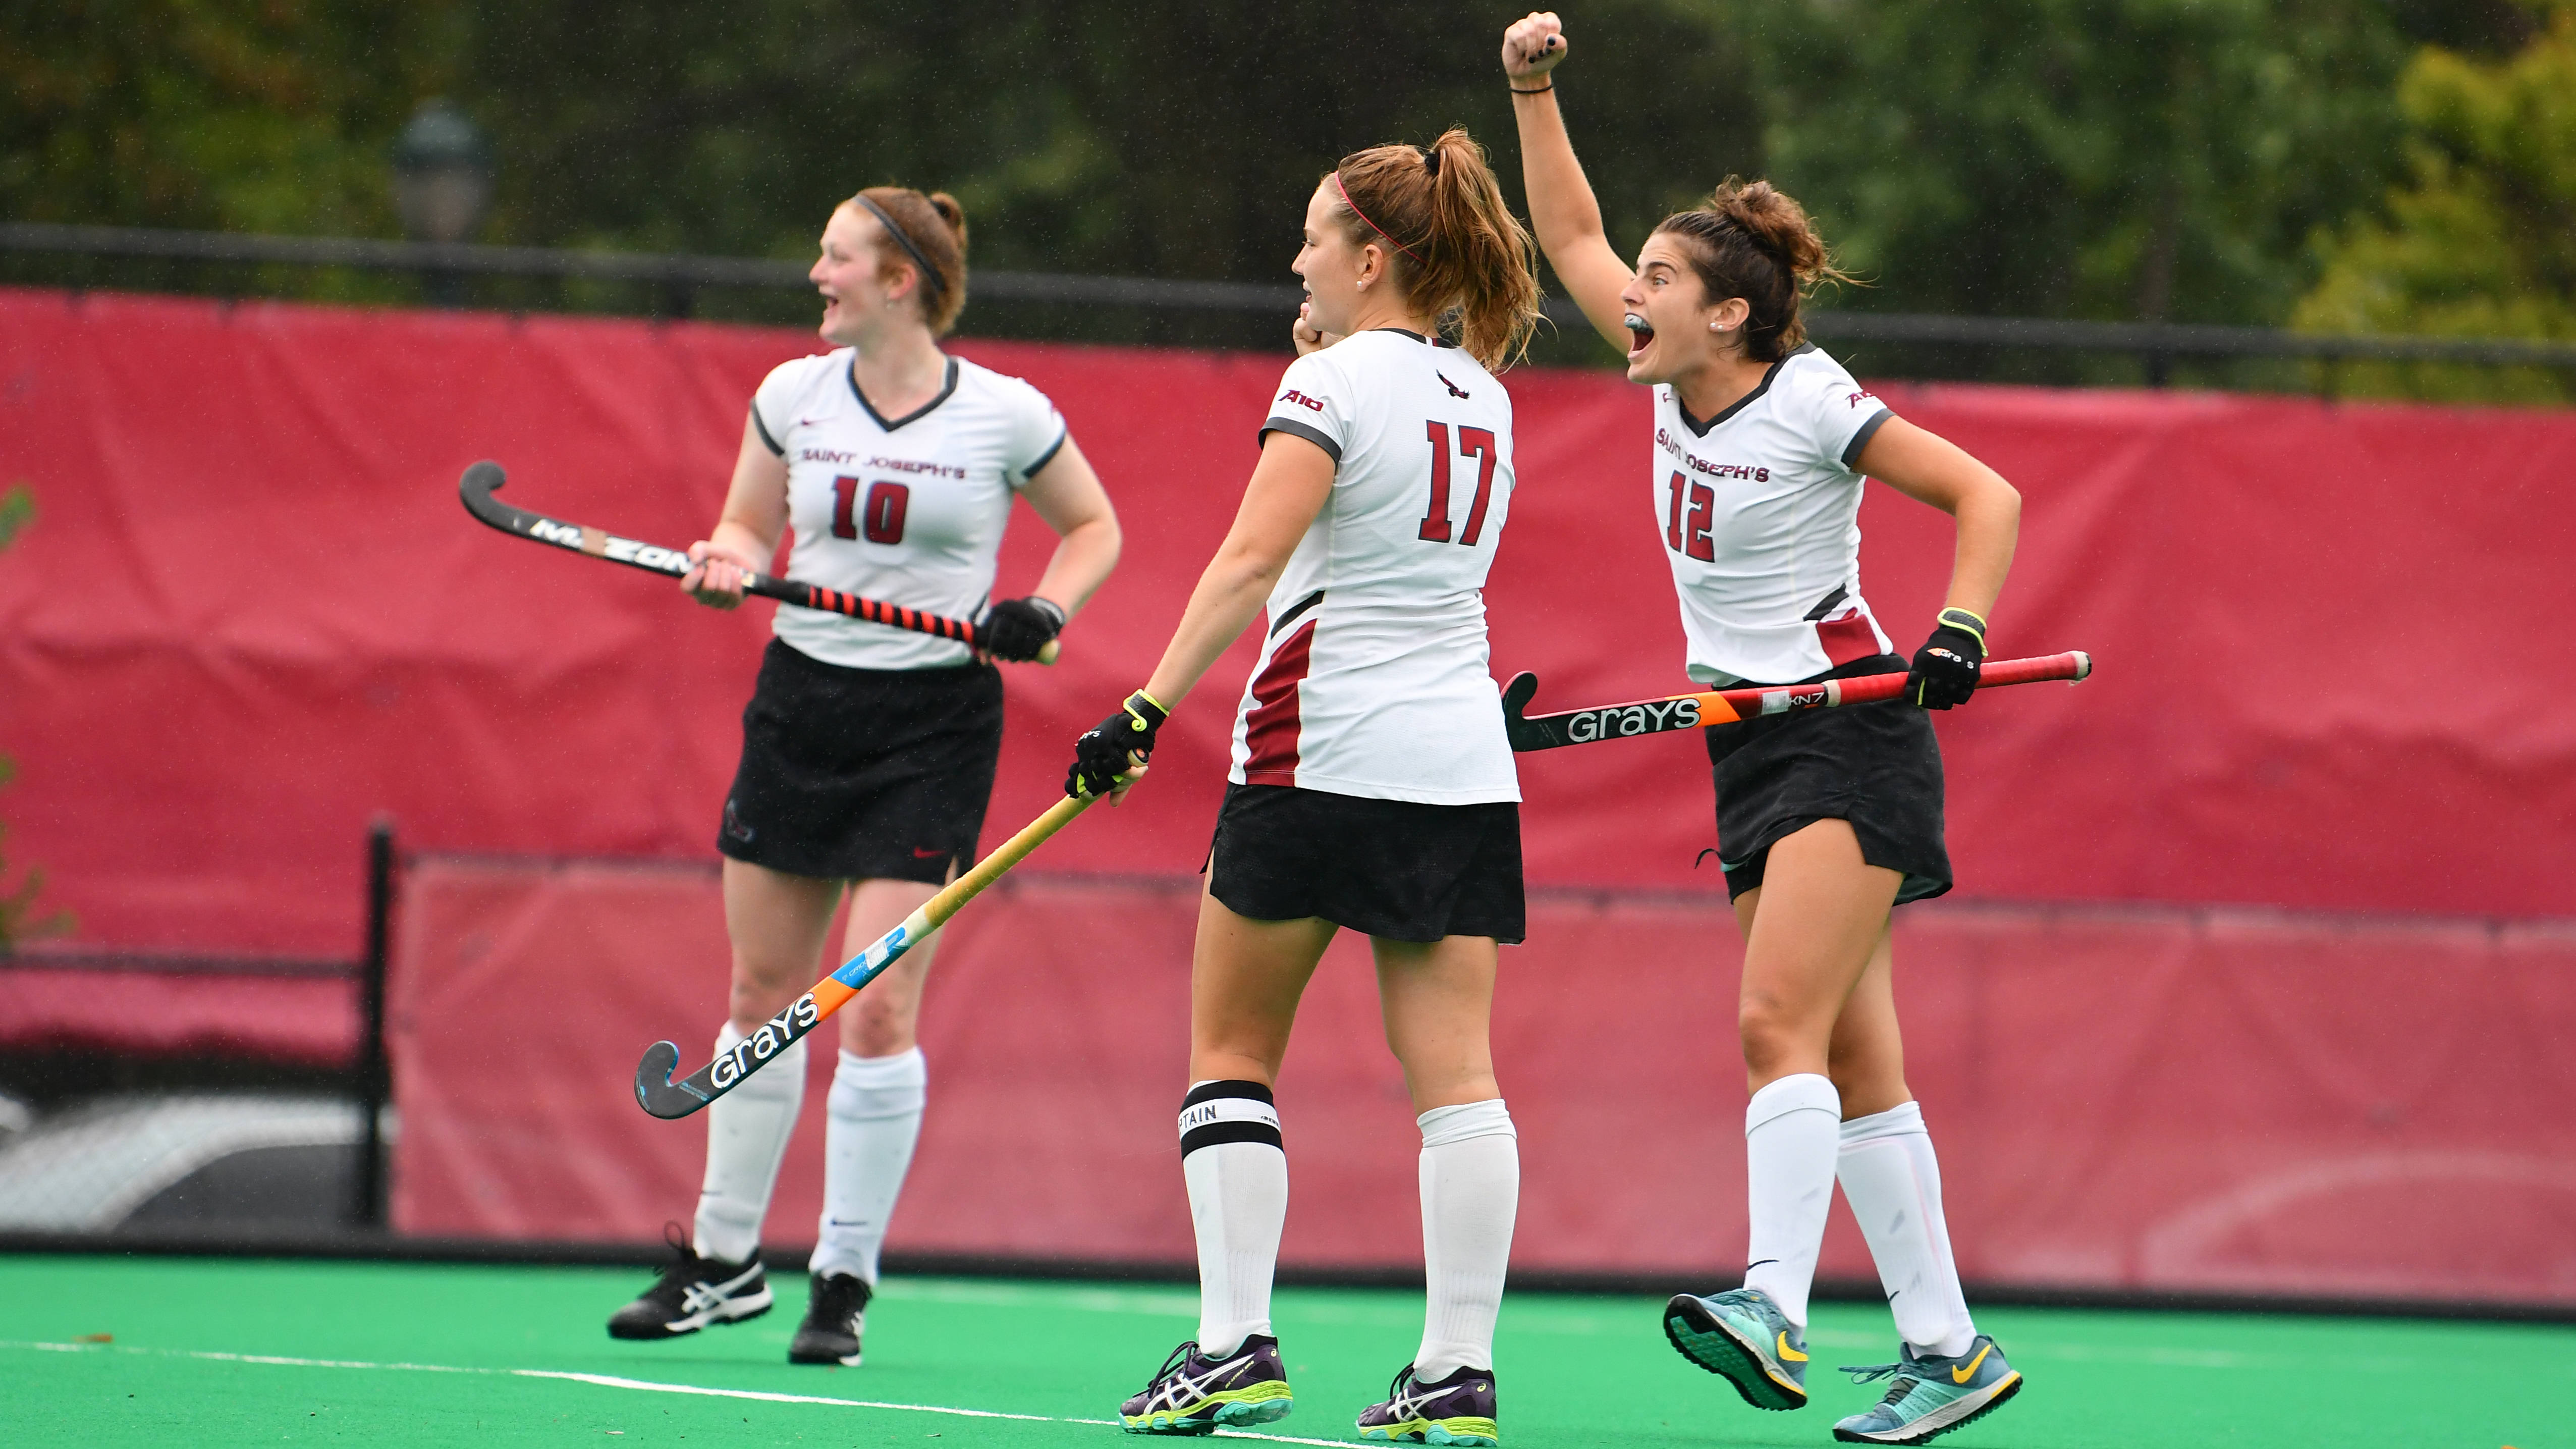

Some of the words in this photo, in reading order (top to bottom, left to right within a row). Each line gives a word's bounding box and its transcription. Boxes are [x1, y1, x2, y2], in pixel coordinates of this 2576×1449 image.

[802, 448, 857, 464] SAINT
[863, 455, 965, 479] JOSEPH'S
[1417, 419, 1497, 547] 17
[1684, 451, 1770, 482] OSEPH'S
[832, 474, 909, 545] 10
[1667, 469, 1716, 563] 12
[529, 518, 695, 574] MZON
